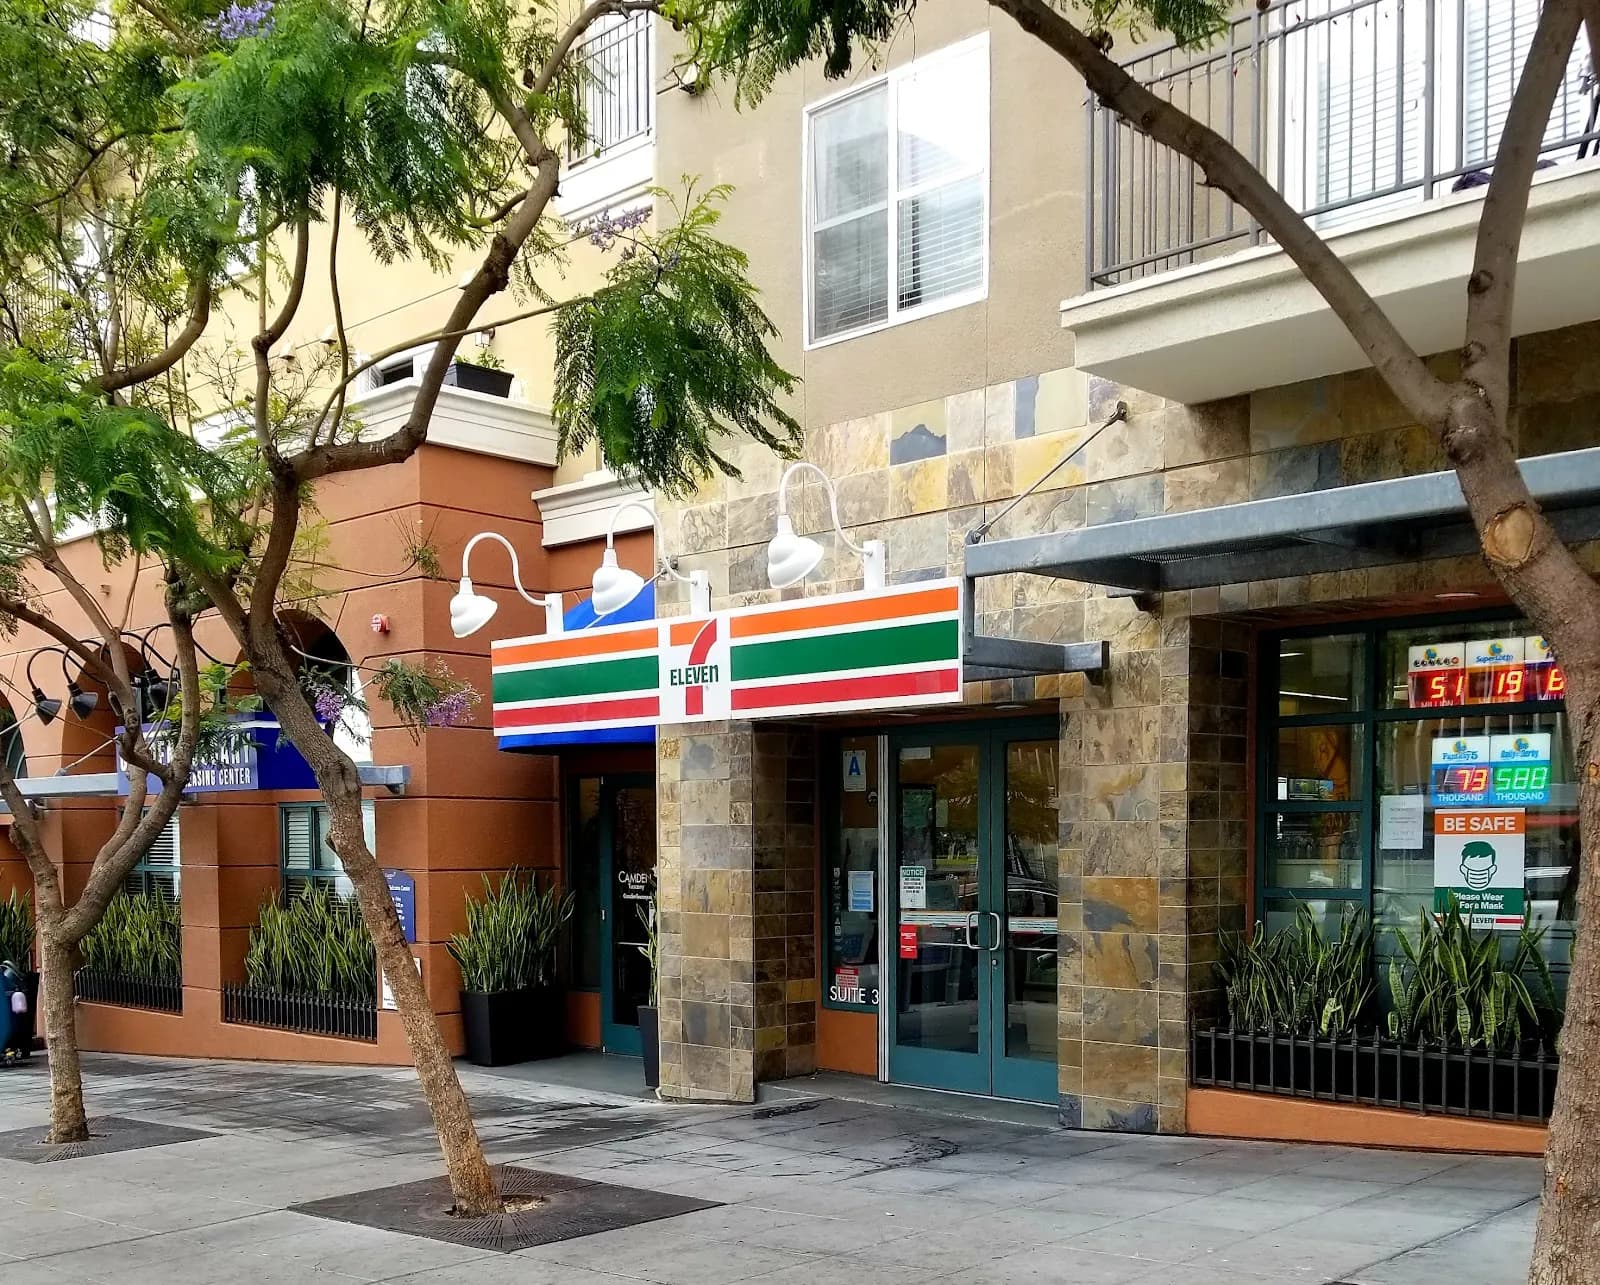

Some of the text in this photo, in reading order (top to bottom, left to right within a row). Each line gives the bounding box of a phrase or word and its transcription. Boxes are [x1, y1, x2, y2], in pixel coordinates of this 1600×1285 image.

[670, 618, 717, 715] 7
[1498, 670, 1523, 694] 19
[848, 756, 861, 775] A
[185, 768, 251, 787] EASING CENTER
[1458, 769, 1488, 792] 73
[1496, 767, 1549, 791] 588
[1438, 794, 1484, 802] THOUSAND
[1496, 792, 1545, 801] THOUSAND
[1443, 816, 1516, 831] BE SAFE
[902, 868, 924, 876] NOTICE
[1454, 893, 1504, 901] Please Wear
[1481, 902, 1504, 910] Mask
[830, 985, 867, 1003] SUITE
